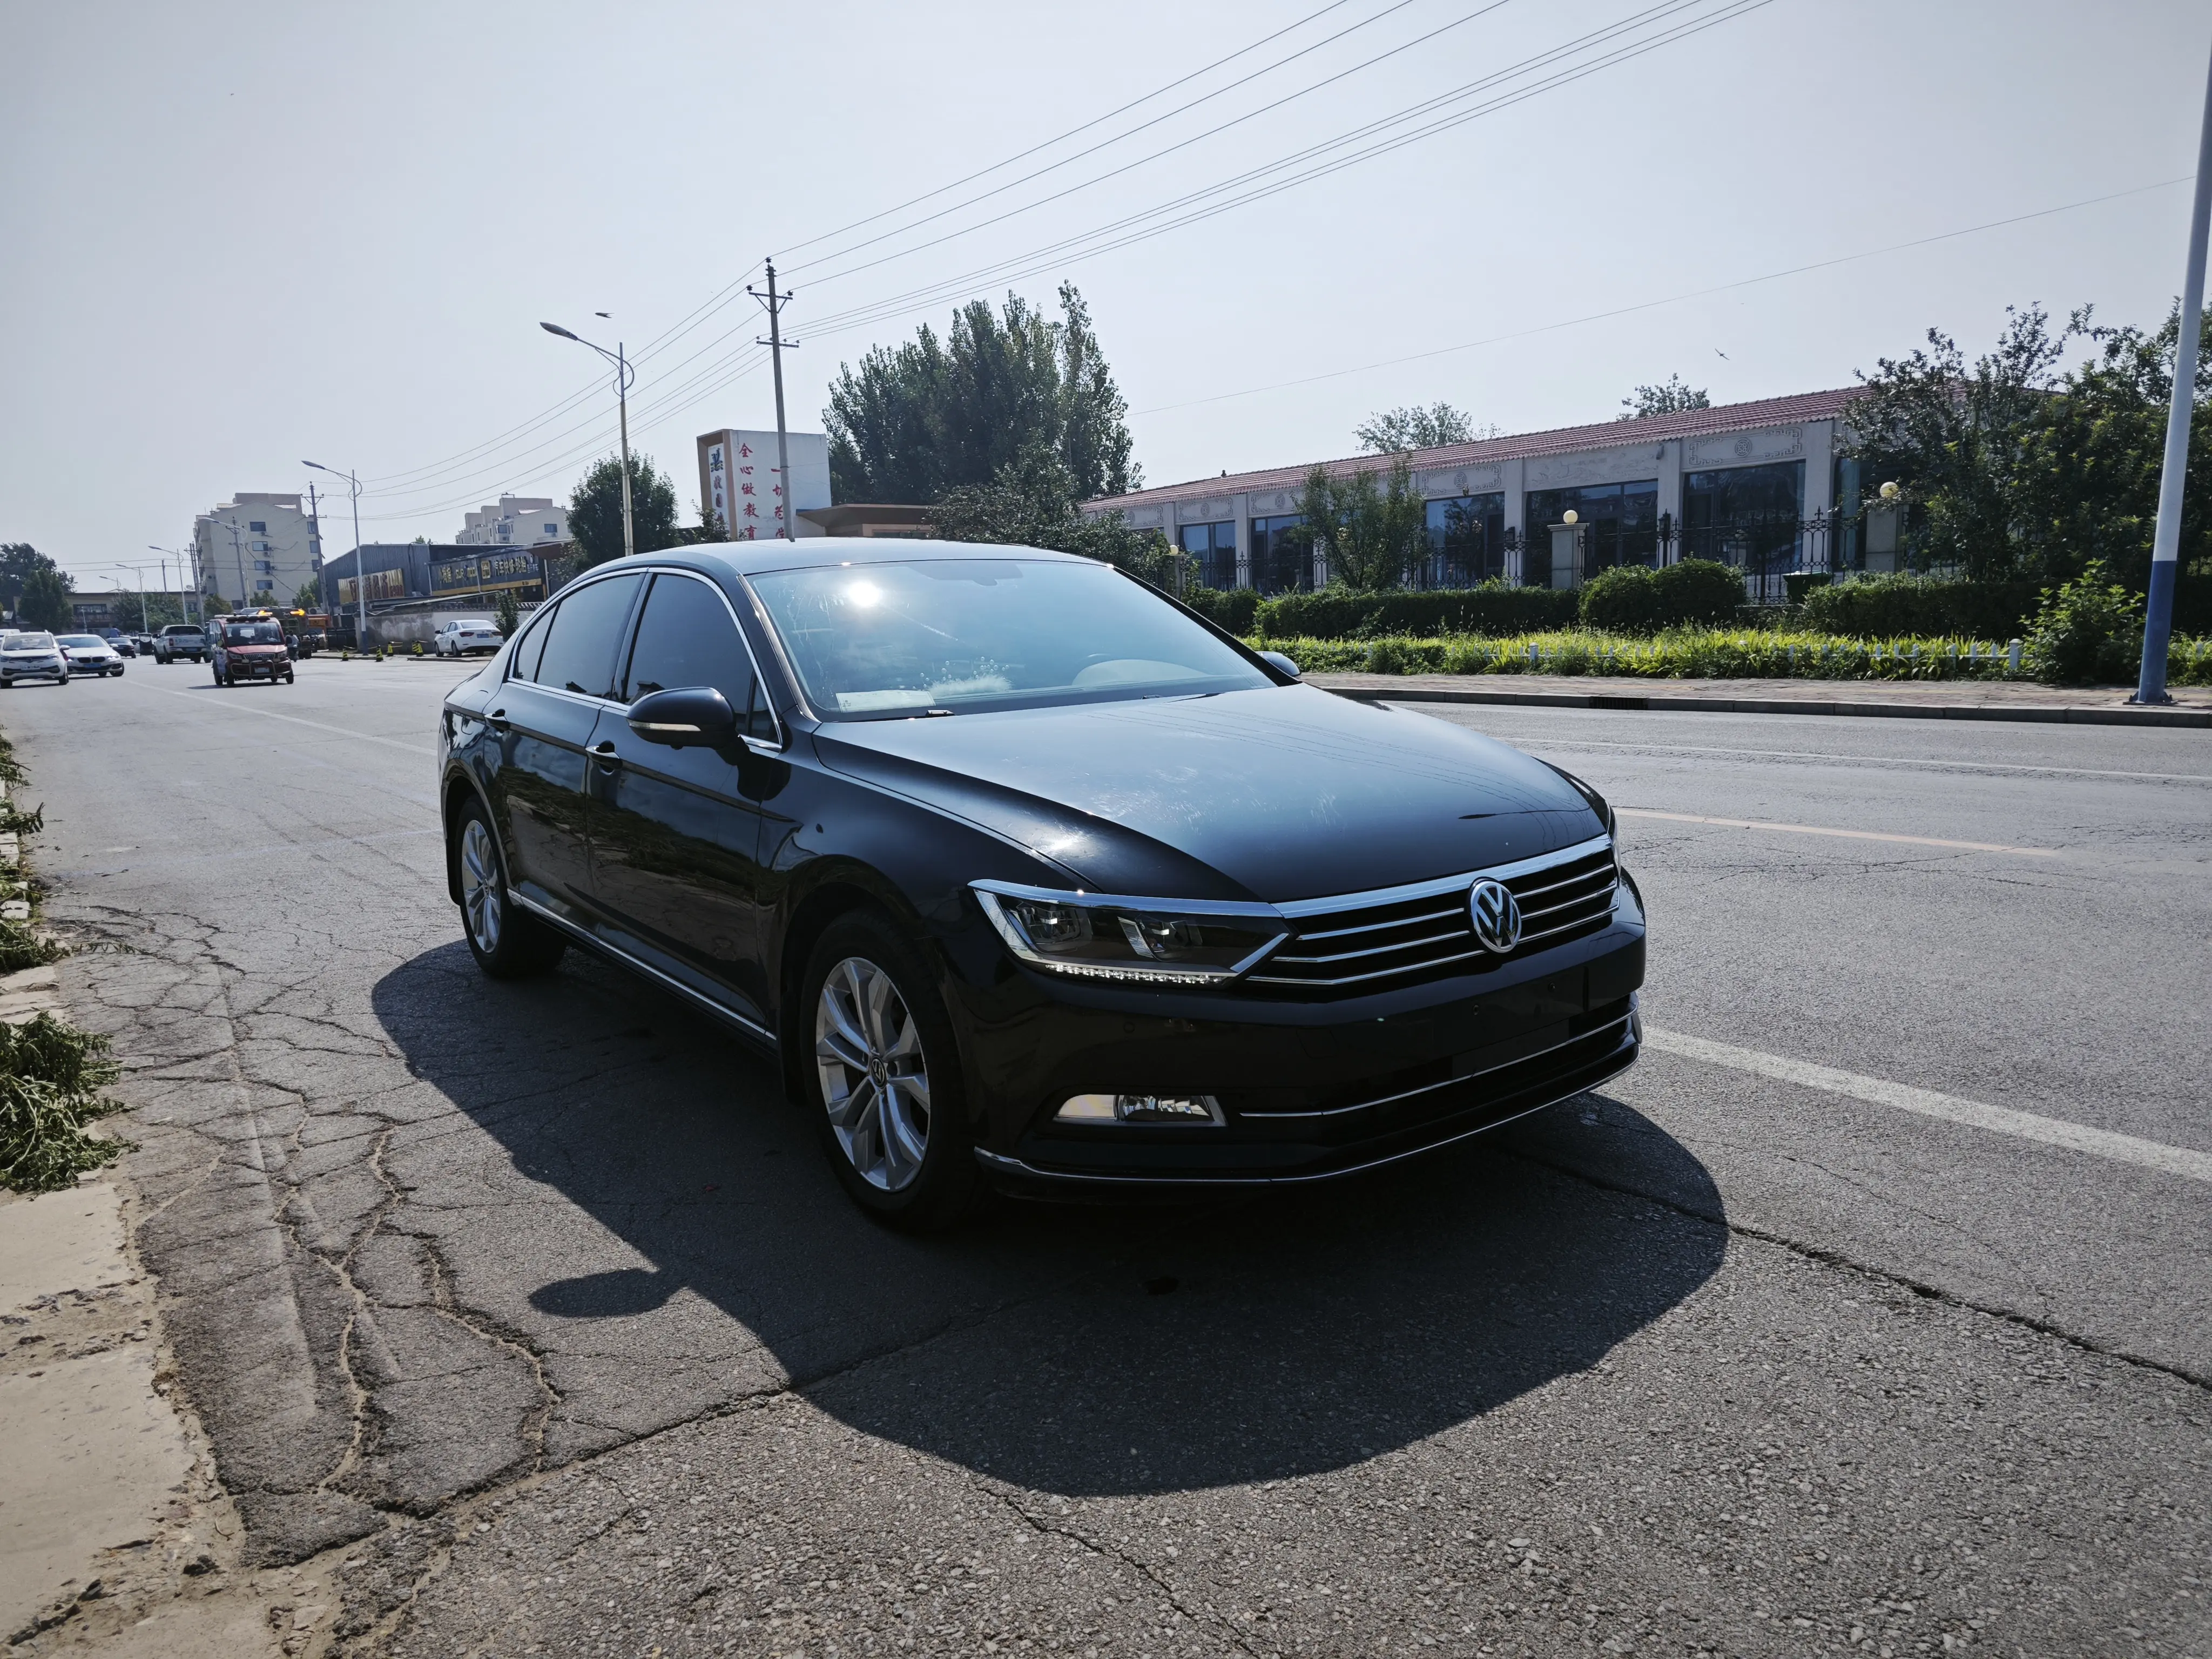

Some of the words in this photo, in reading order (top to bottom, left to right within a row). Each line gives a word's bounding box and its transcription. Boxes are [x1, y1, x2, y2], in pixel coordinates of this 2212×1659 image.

[739, 443, 759, 540] 全心做教育
